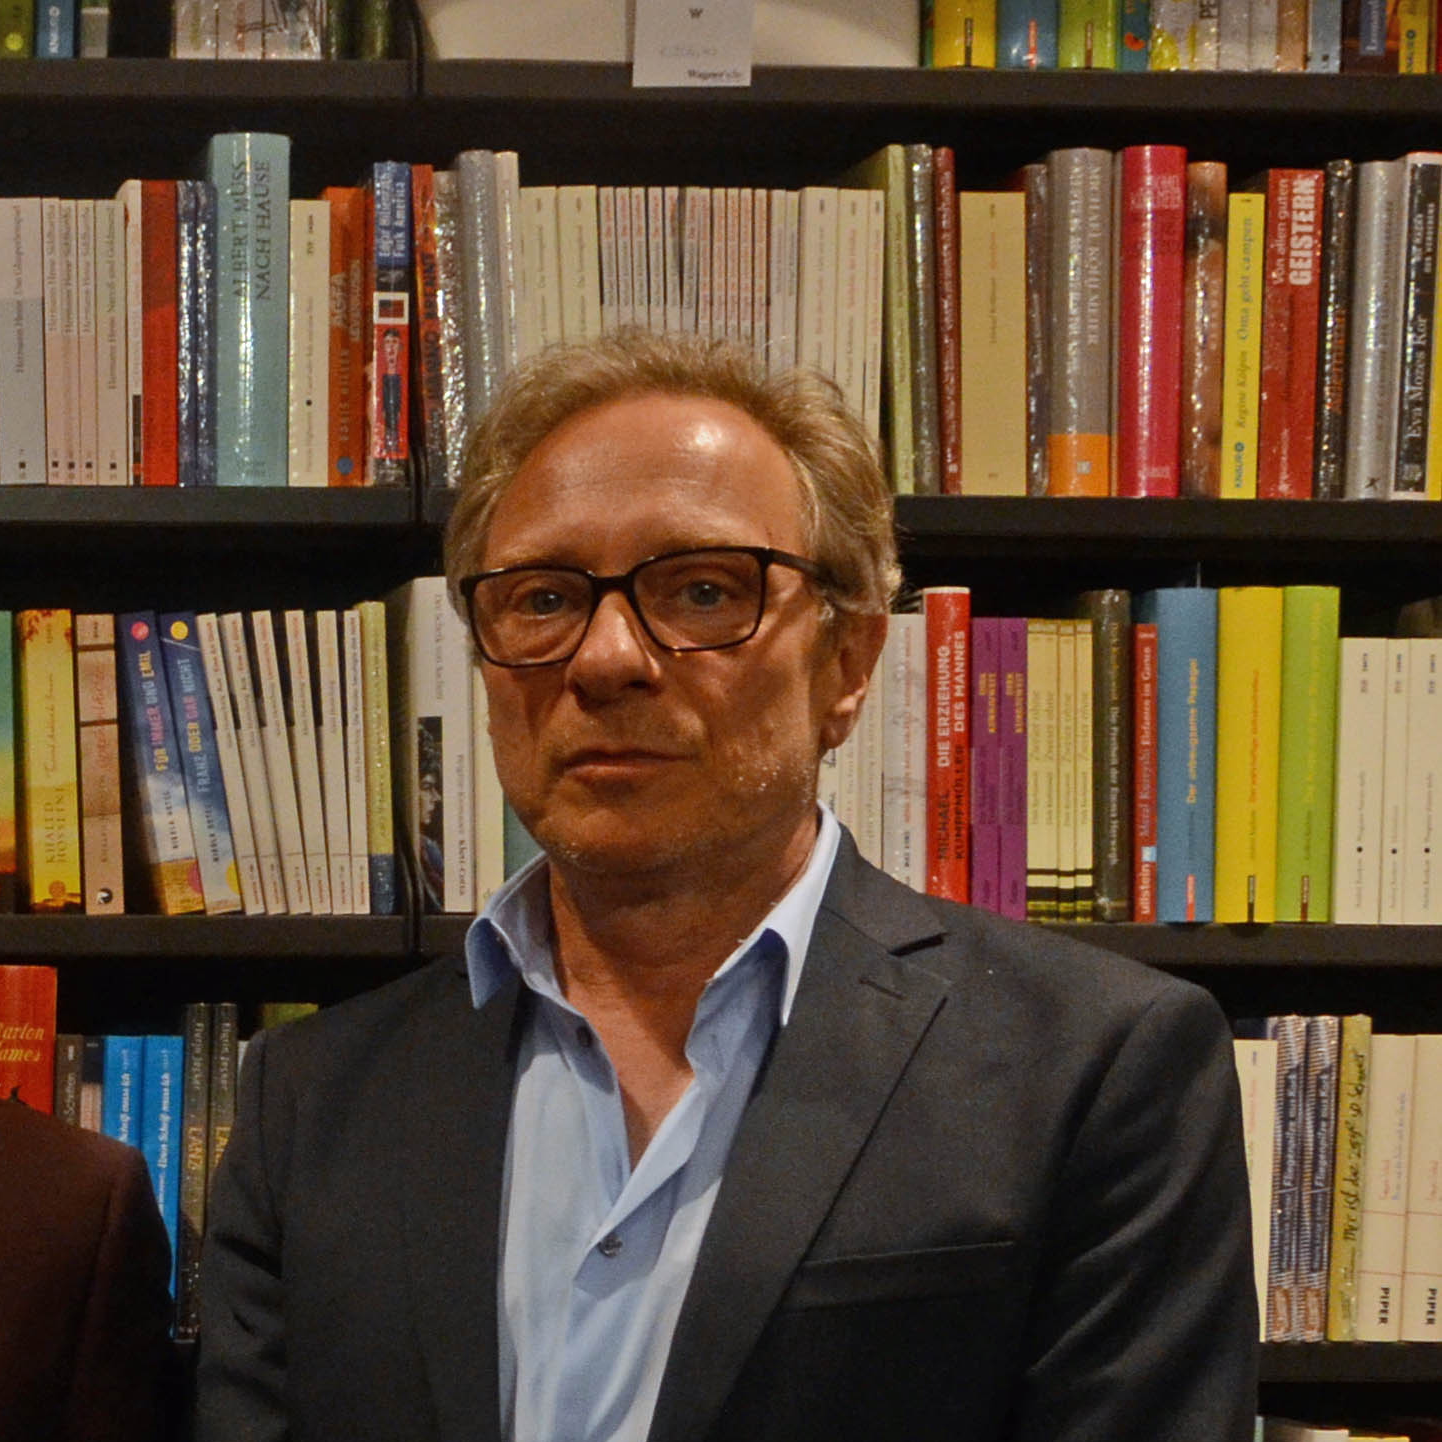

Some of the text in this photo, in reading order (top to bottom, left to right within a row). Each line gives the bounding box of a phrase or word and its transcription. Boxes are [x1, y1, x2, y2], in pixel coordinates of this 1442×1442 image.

[232, 160, 246, 297] ALBERT MUSS
[254, 160, 270, 300] NACH HAUSE
[393, 181, 406, 257] Fuck America
[1272, 178, 1291, 284] Von allen guten
[1291, 177, 1315, 286] GEISTERN
[331, 273, 345, 327] AGFA
[1236, 307, 1249, 341] Oma
[1238, 276, 1253, 304] geht
[1408, 314, 1429, 438] Eva Mozes Kor
[139, 650, 167, 770] FÜR IMMER UND EMIL
[178, 658, 209, 792] FRANZ ODER GAR NICHT
[937, 646, 950, 767] DIE ERZIEHUNG
[954, 630, 965, 732] DES MANNES
[1188, 783, 1199, 804] Der
[1288, 1073, 1297, 1097] Kork
[1320, 1073, 1330, 1097] Kork
[1285, 1099, 1295, 1187] Fliegenpilze aus
[1317, 1099, 1328, 1187] Fliegenpilze aus
[1378, 1287, 1390, 1326] PIPER
